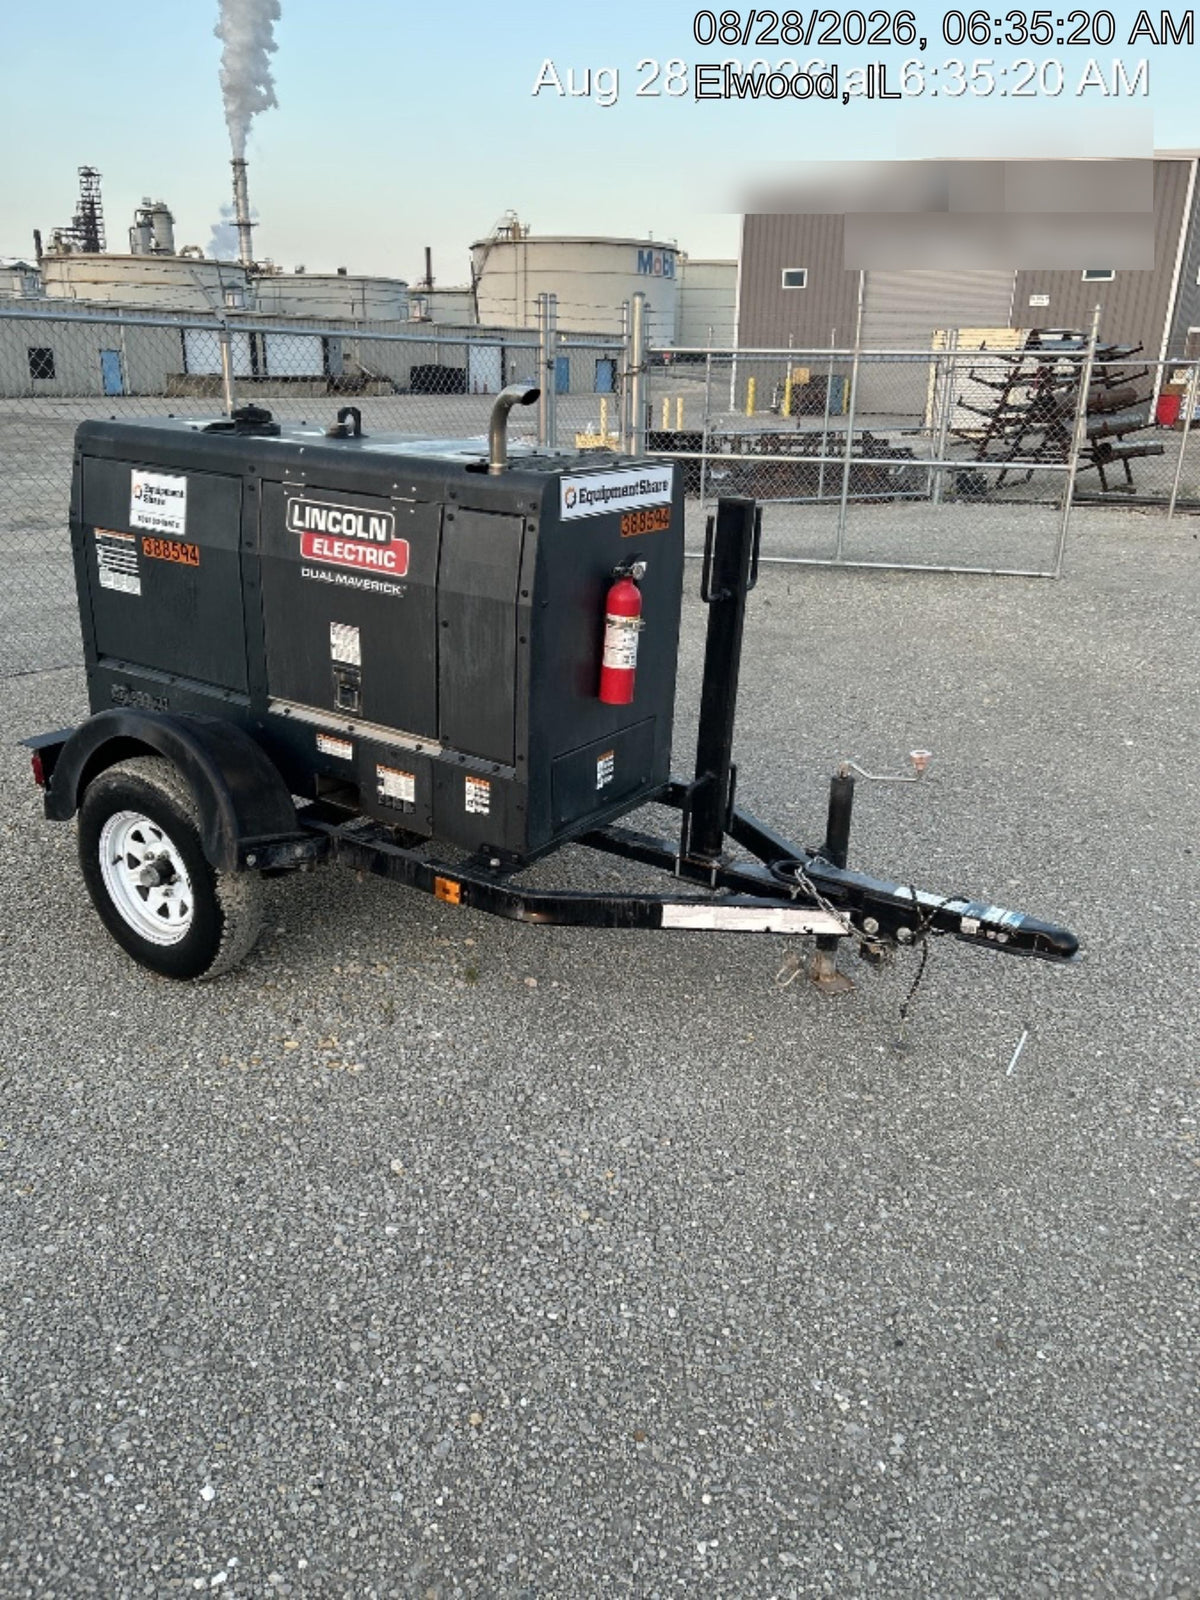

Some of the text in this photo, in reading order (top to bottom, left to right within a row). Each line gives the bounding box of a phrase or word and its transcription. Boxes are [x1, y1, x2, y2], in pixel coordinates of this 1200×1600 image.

[637, 249, 674, 277] Mobi
[578, 478, 669, 506] EquipmentShare
[292, 504, 387, 541] LINCOLN
[621, 508, 670, 536] 388594
[144, 537, 199, 565] 388594
[312, 537, 397, 568] ELECTRIC
